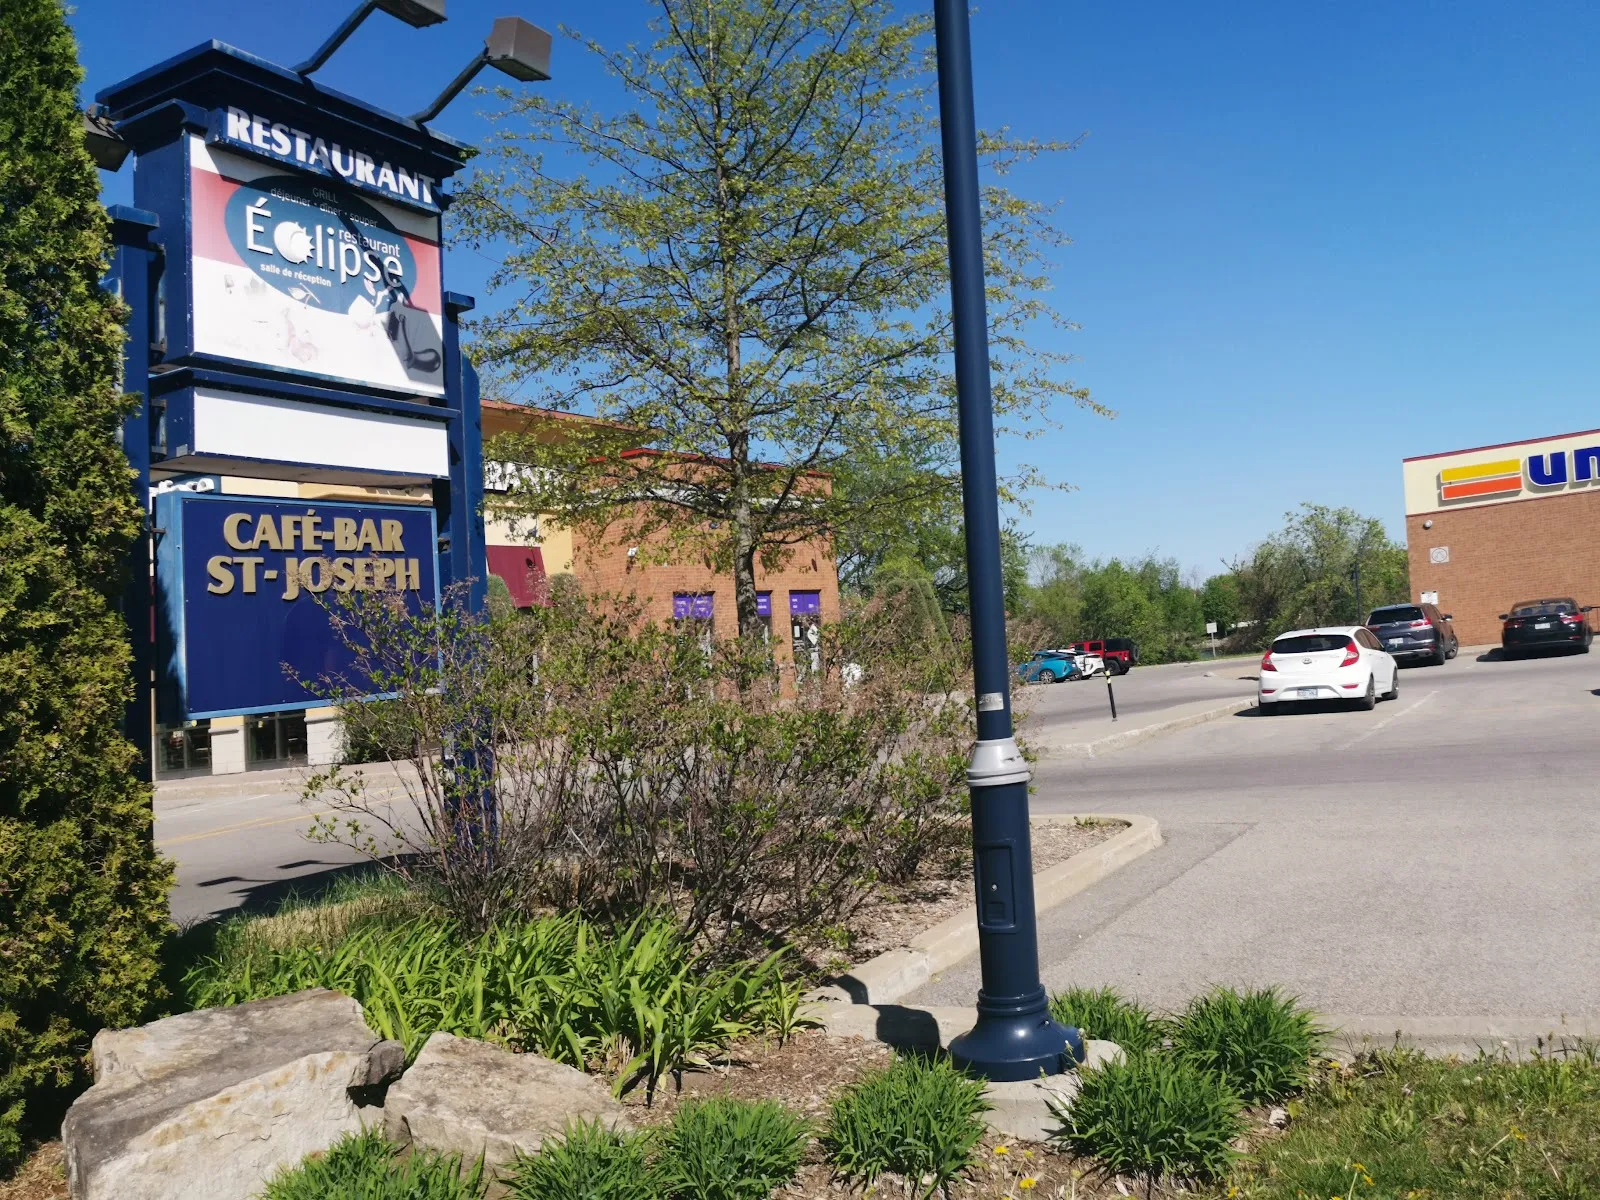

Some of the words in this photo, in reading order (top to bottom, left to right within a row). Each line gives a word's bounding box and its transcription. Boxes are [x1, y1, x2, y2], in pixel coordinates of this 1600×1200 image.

[227, 105, 436, 205] RESTAURANT
[270, 187, 311, 208] déjeuner
[319, 202, 342, 217] dîner
[350, 212, 378, 228] souper
[312, 187, 339, 204] GRILL
[338, 229, 401, 258] restaurant
[260, 262, 281, 276] salle
[282, 267, 293, 279] de
[293, 270, 332, 288] réception
[223, 508, 405, 553] CAFÉ-BAR
[206, 555, 421, 601] ST-JOSEPH
